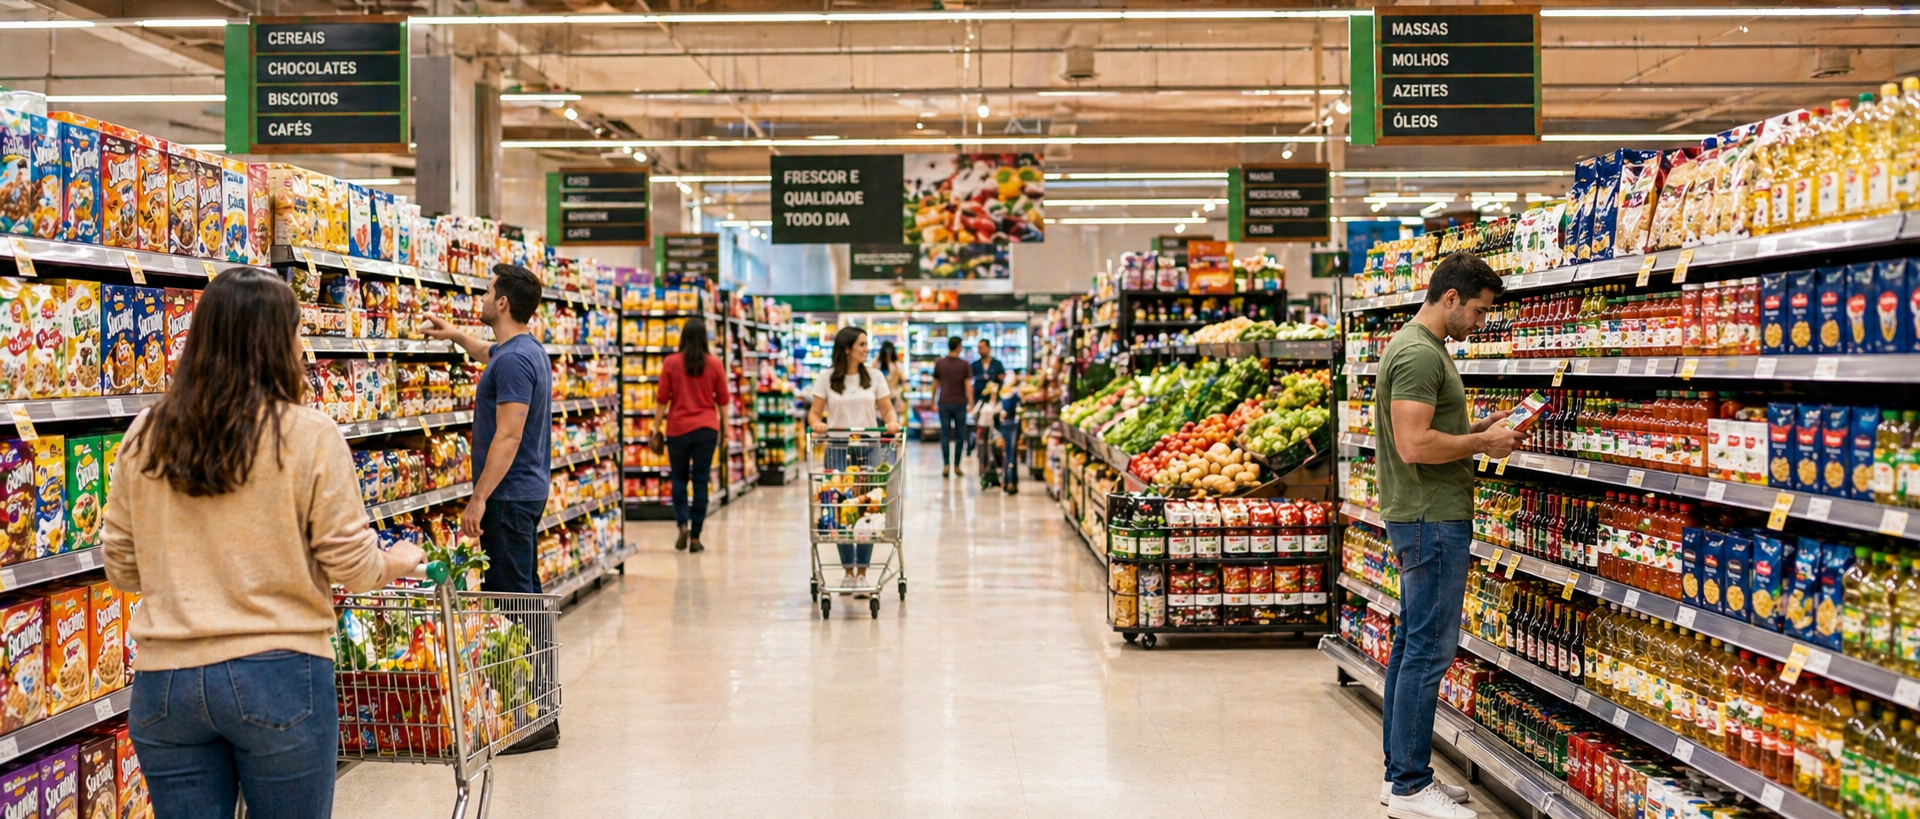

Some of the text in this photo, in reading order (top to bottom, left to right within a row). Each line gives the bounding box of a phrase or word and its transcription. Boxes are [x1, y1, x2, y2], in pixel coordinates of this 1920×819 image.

[1392, 22, 1449, 36] MASSAS
[267, 31, 326, 45] CEREAIS
[1392, 53, 1449, 67] MOLHOS
[267, 61, 357, 75] CHOCOLATES
[1392, 84, 1449, 98] AZEITES
[267, 92, 339, 106] BISCOITOS
[1393, 112, 1439, 128] ÓLEOS
[267, 120, 313, 136] CAFÉS
[783, 169, 860, 184] FRESCOR E
[783, 191, 865, 207] QUALIDADE
[783, 212, 851, 227] TODO DIA
